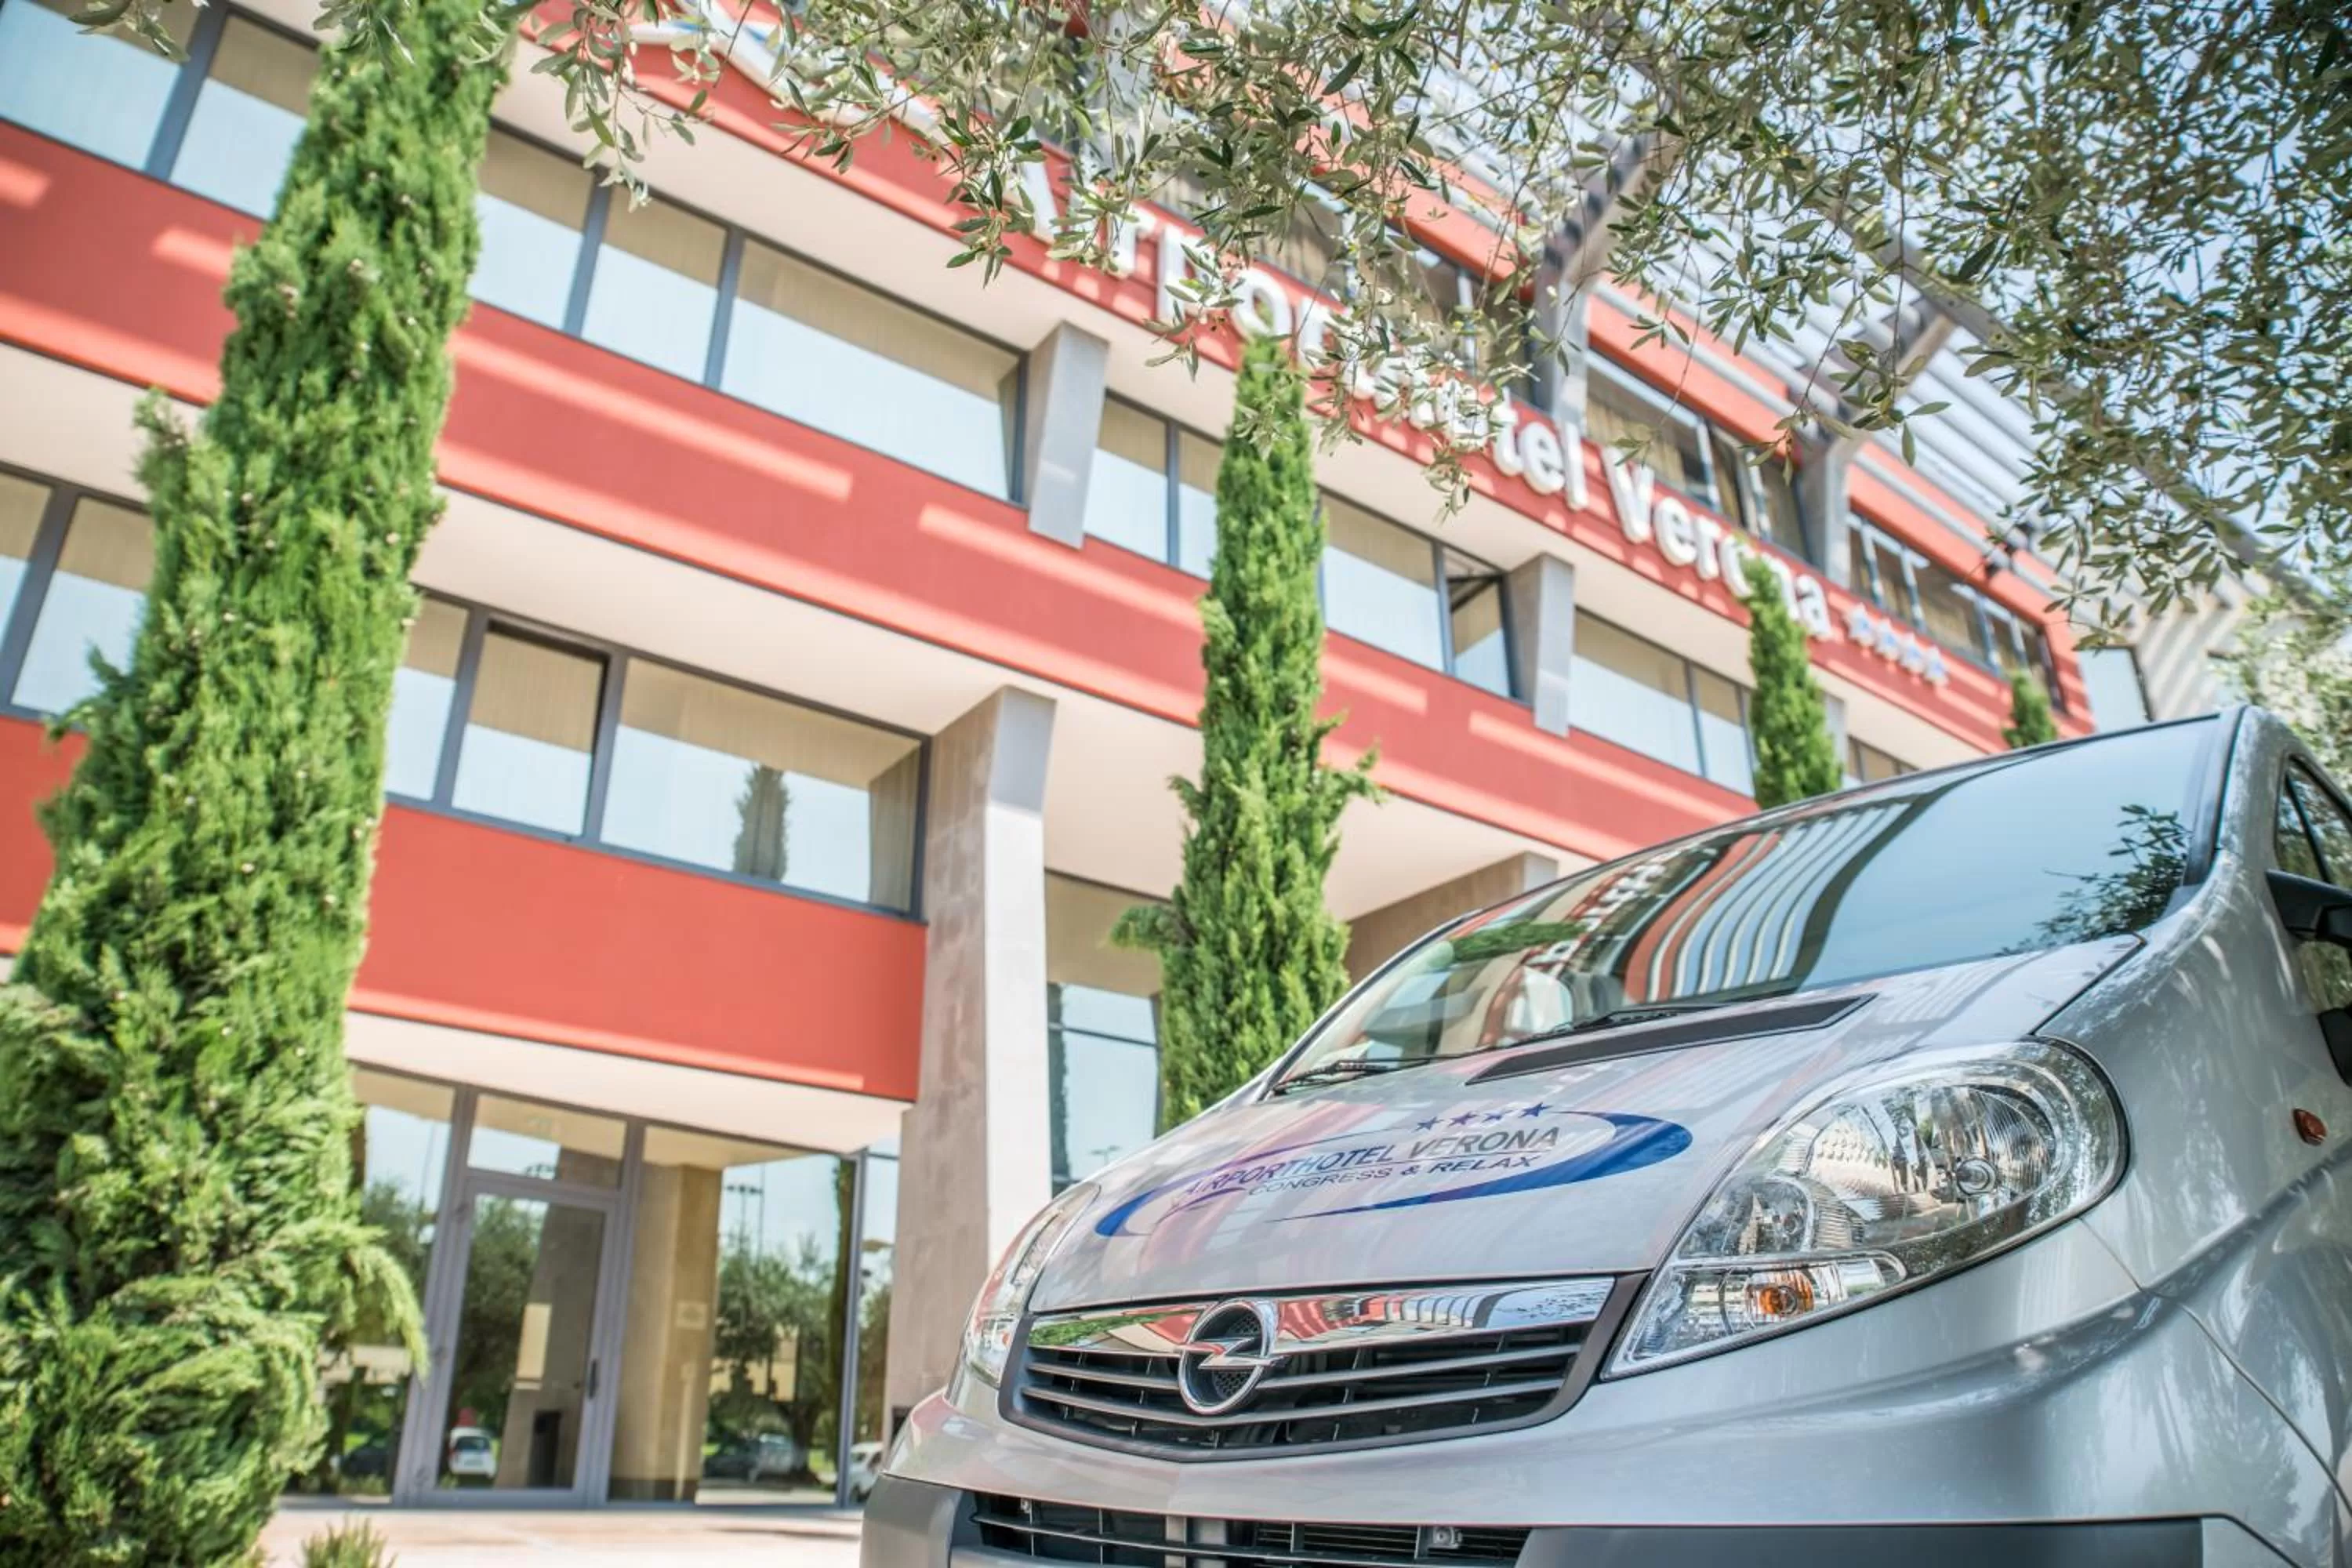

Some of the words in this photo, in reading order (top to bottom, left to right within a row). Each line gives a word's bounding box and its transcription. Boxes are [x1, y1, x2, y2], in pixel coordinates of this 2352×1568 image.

[1601, 442, 1832, 641] Verona
[1409, 1127, 1559, 1159] VERONA
[1248, 1167, 1393, 1196] CONGRESS
[1400, 1165, 1419, 1176] &
[1428, 1155, 1541, 1174] RELAX
